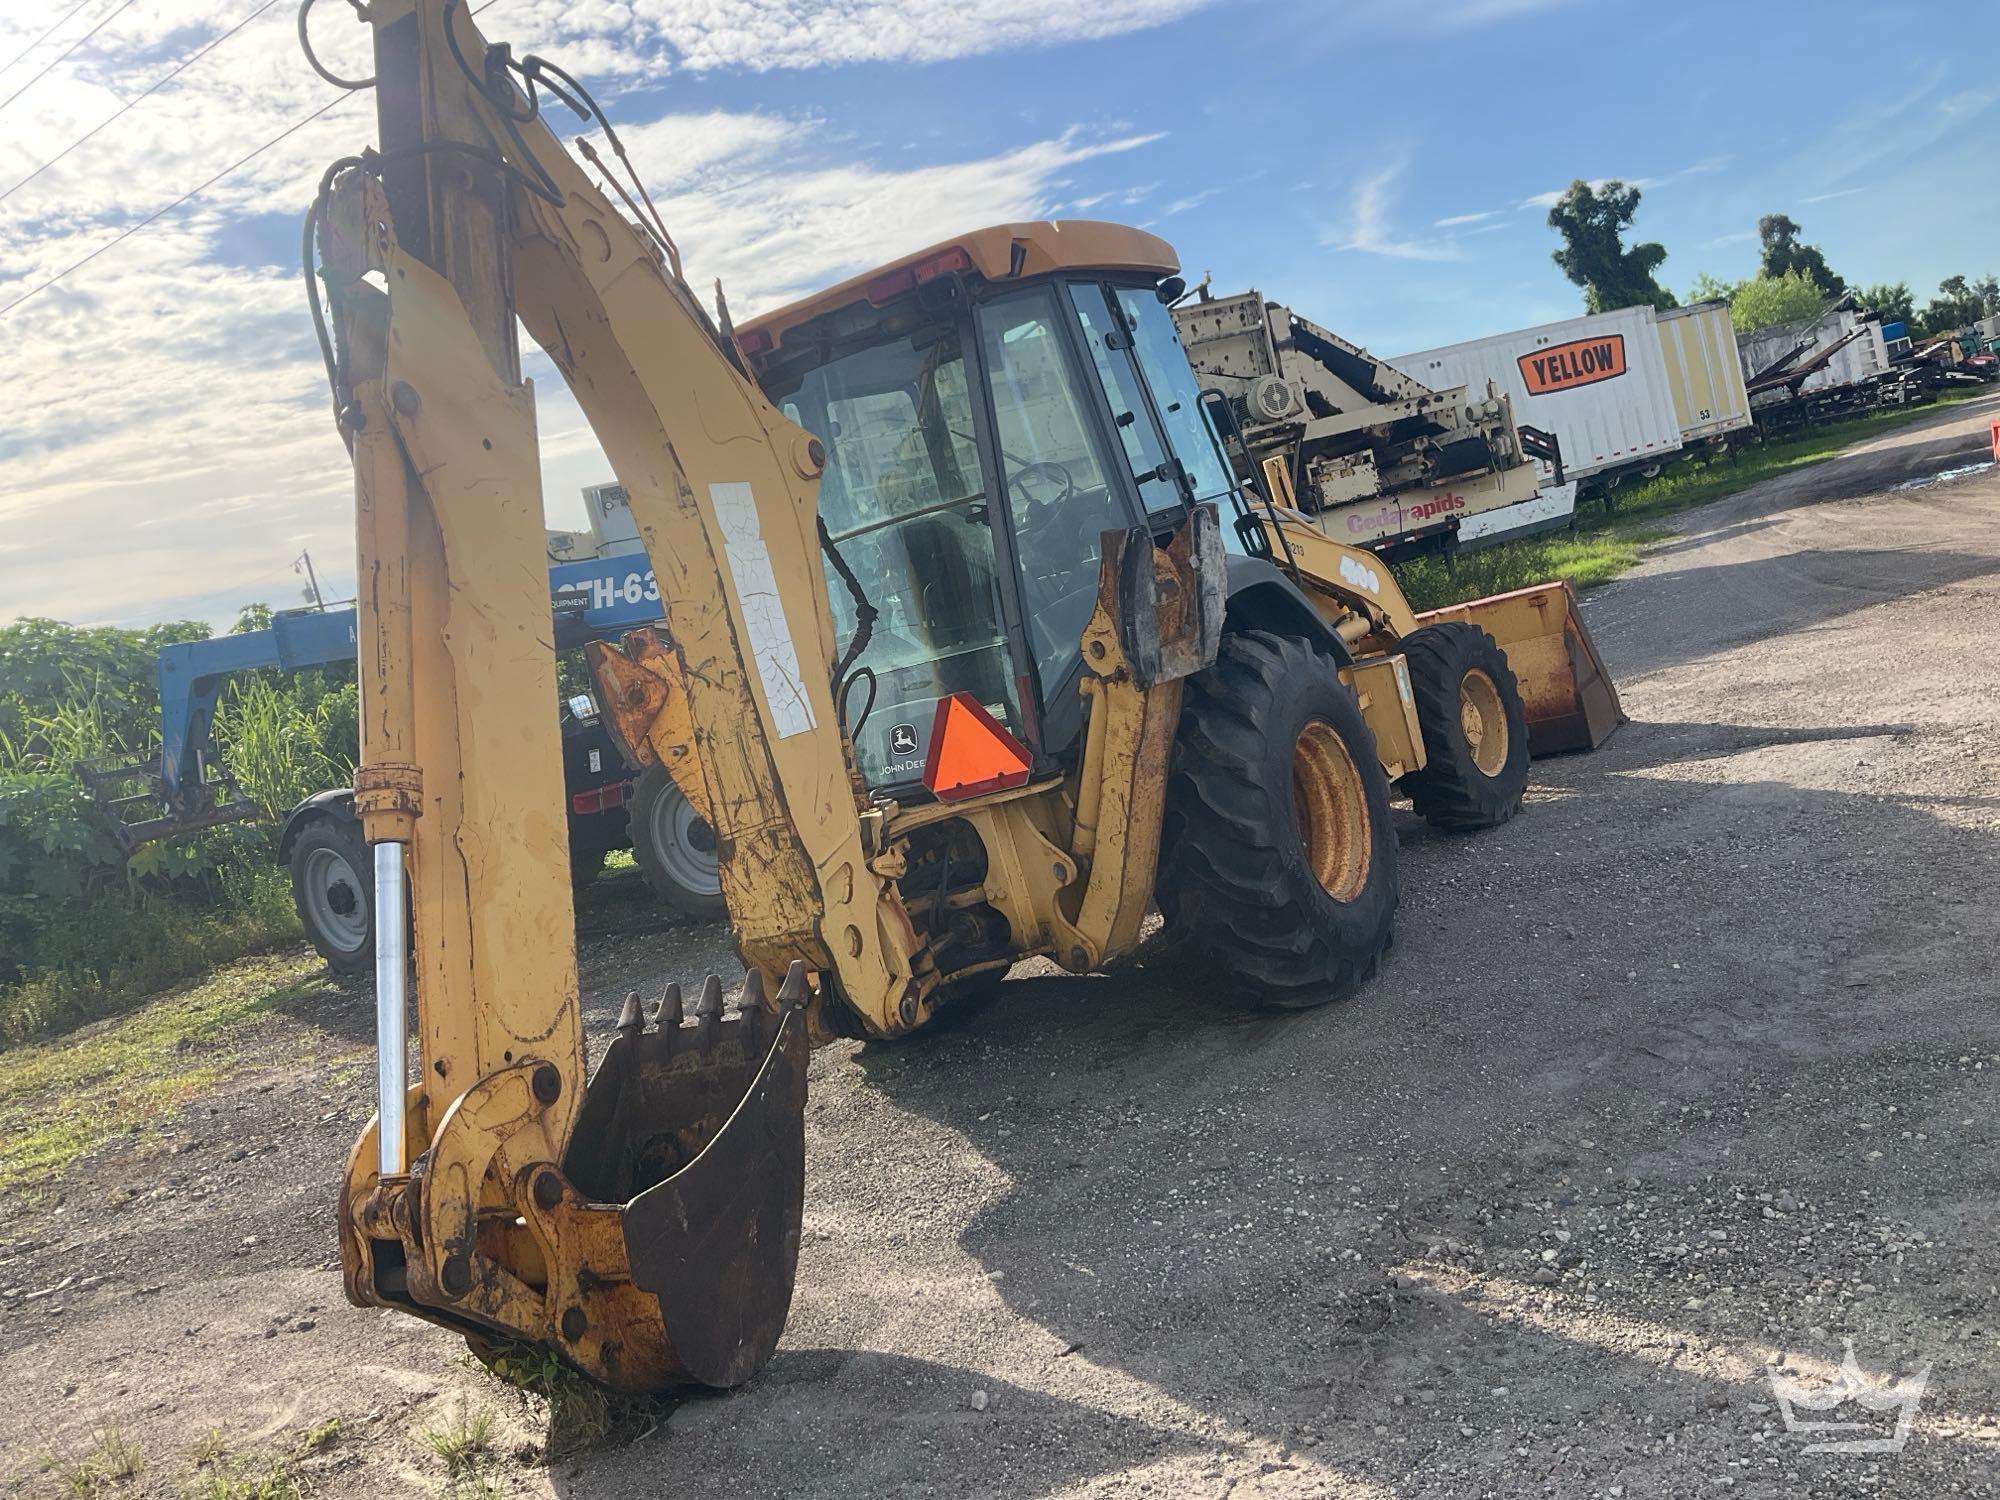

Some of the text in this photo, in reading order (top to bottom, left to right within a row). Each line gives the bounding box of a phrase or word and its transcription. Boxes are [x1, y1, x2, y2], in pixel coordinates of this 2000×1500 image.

[1532, 344, 1613, 385] YELLOW
[1700, 410, 1710, 420] 53
[1347, 493, 1467, 533] Cedarapids
[880, 764, 905, 775] JOHN
